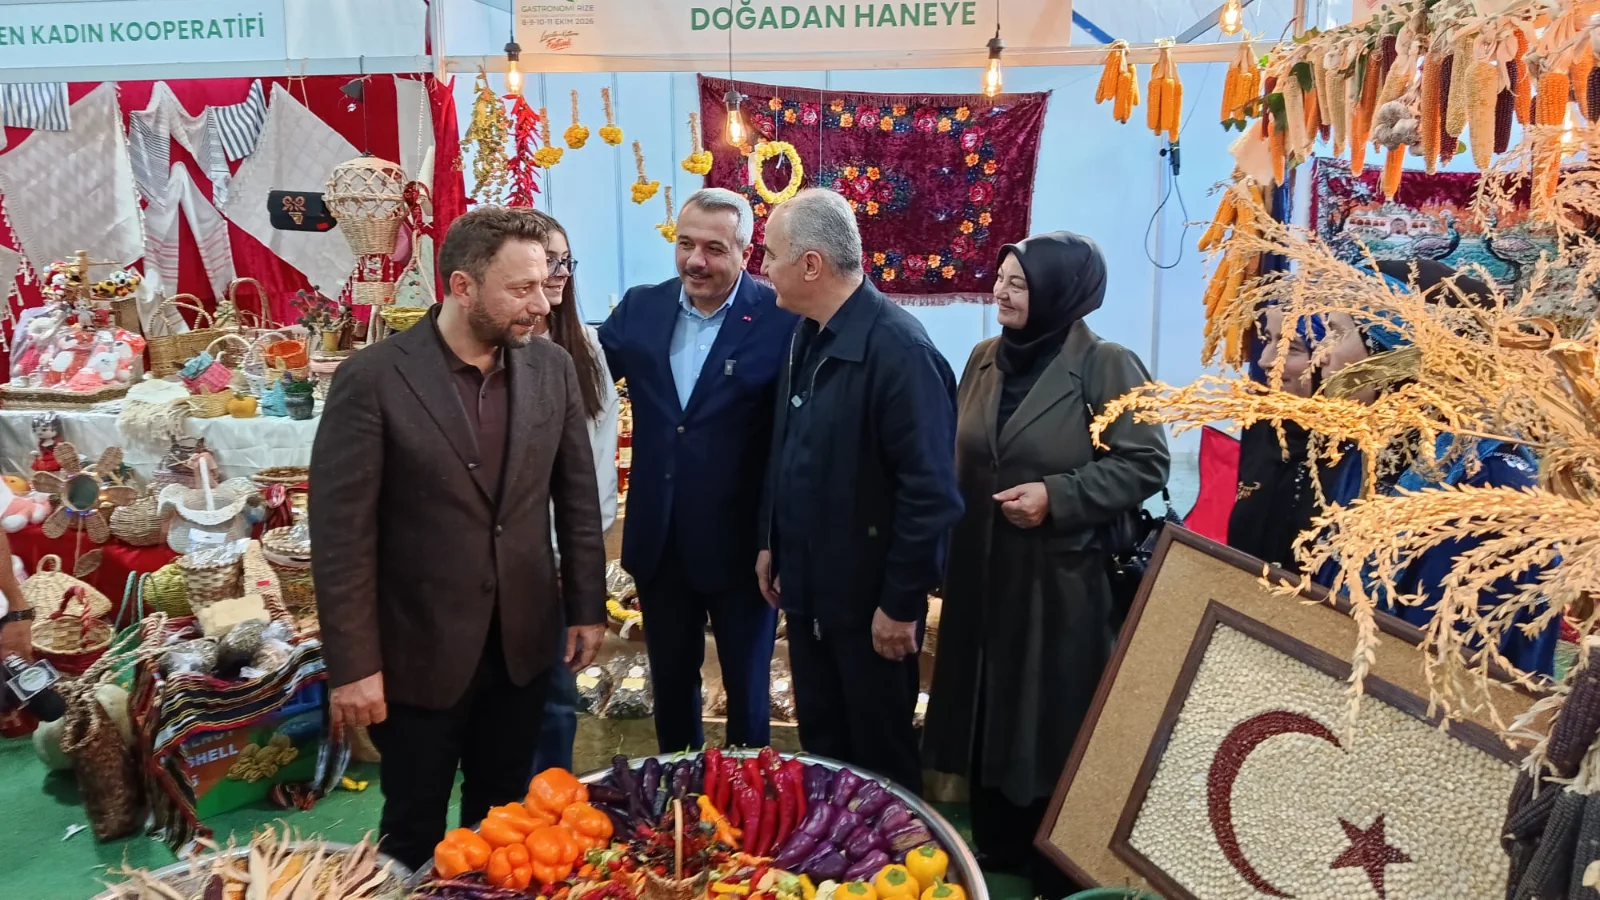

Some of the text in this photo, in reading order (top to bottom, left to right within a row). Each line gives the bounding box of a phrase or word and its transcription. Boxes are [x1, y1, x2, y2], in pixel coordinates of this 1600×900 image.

[31, 23, 104, 45] KADIN
[110, 12, 265, 42] KOOPERATİFİ
[691, 0, 977, 30] DOĞADAN HANEYE
[186, 744, 239, 768] SHELL
